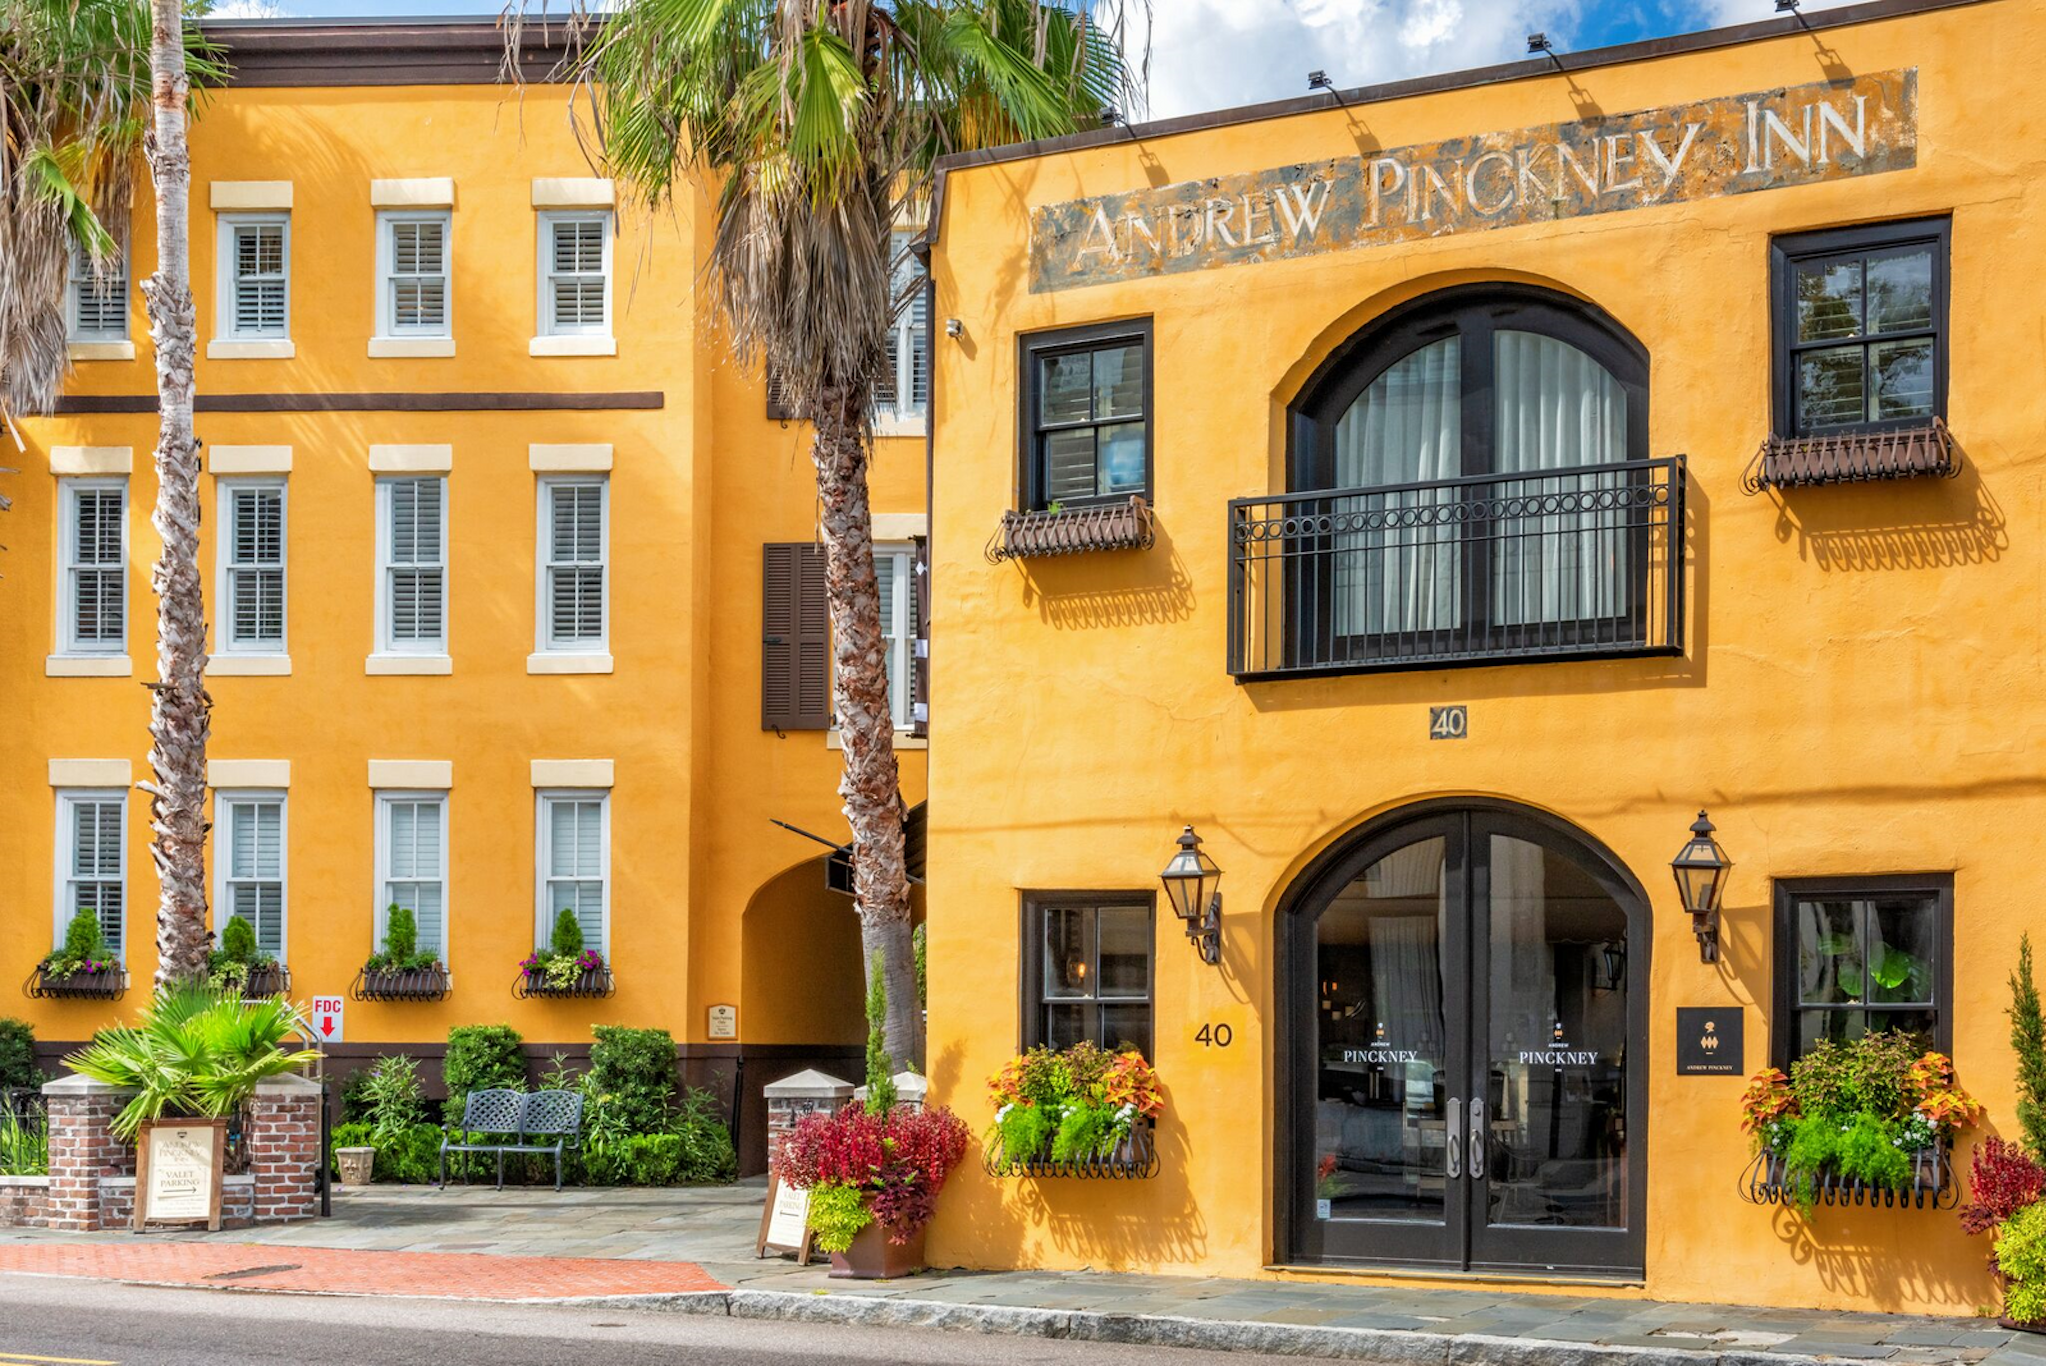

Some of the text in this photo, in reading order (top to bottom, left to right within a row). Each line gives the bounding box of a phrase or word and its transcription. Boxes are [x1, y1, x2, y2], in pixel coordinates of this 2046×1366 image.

[1068, 95, 1868, 273] ANDREW PINCKNEY INN
[1431, 709, 1465, 736] 40
[315, 1000, 341, 1013] FDC
[1195, 1023, 1232, 1047] 40
[1344, 1050, 1418, 1063] PINCKNEY
[1519, 1051, 1598, 1065] PINCKNEY
[161, 1179, 200, 1187] PARKING
